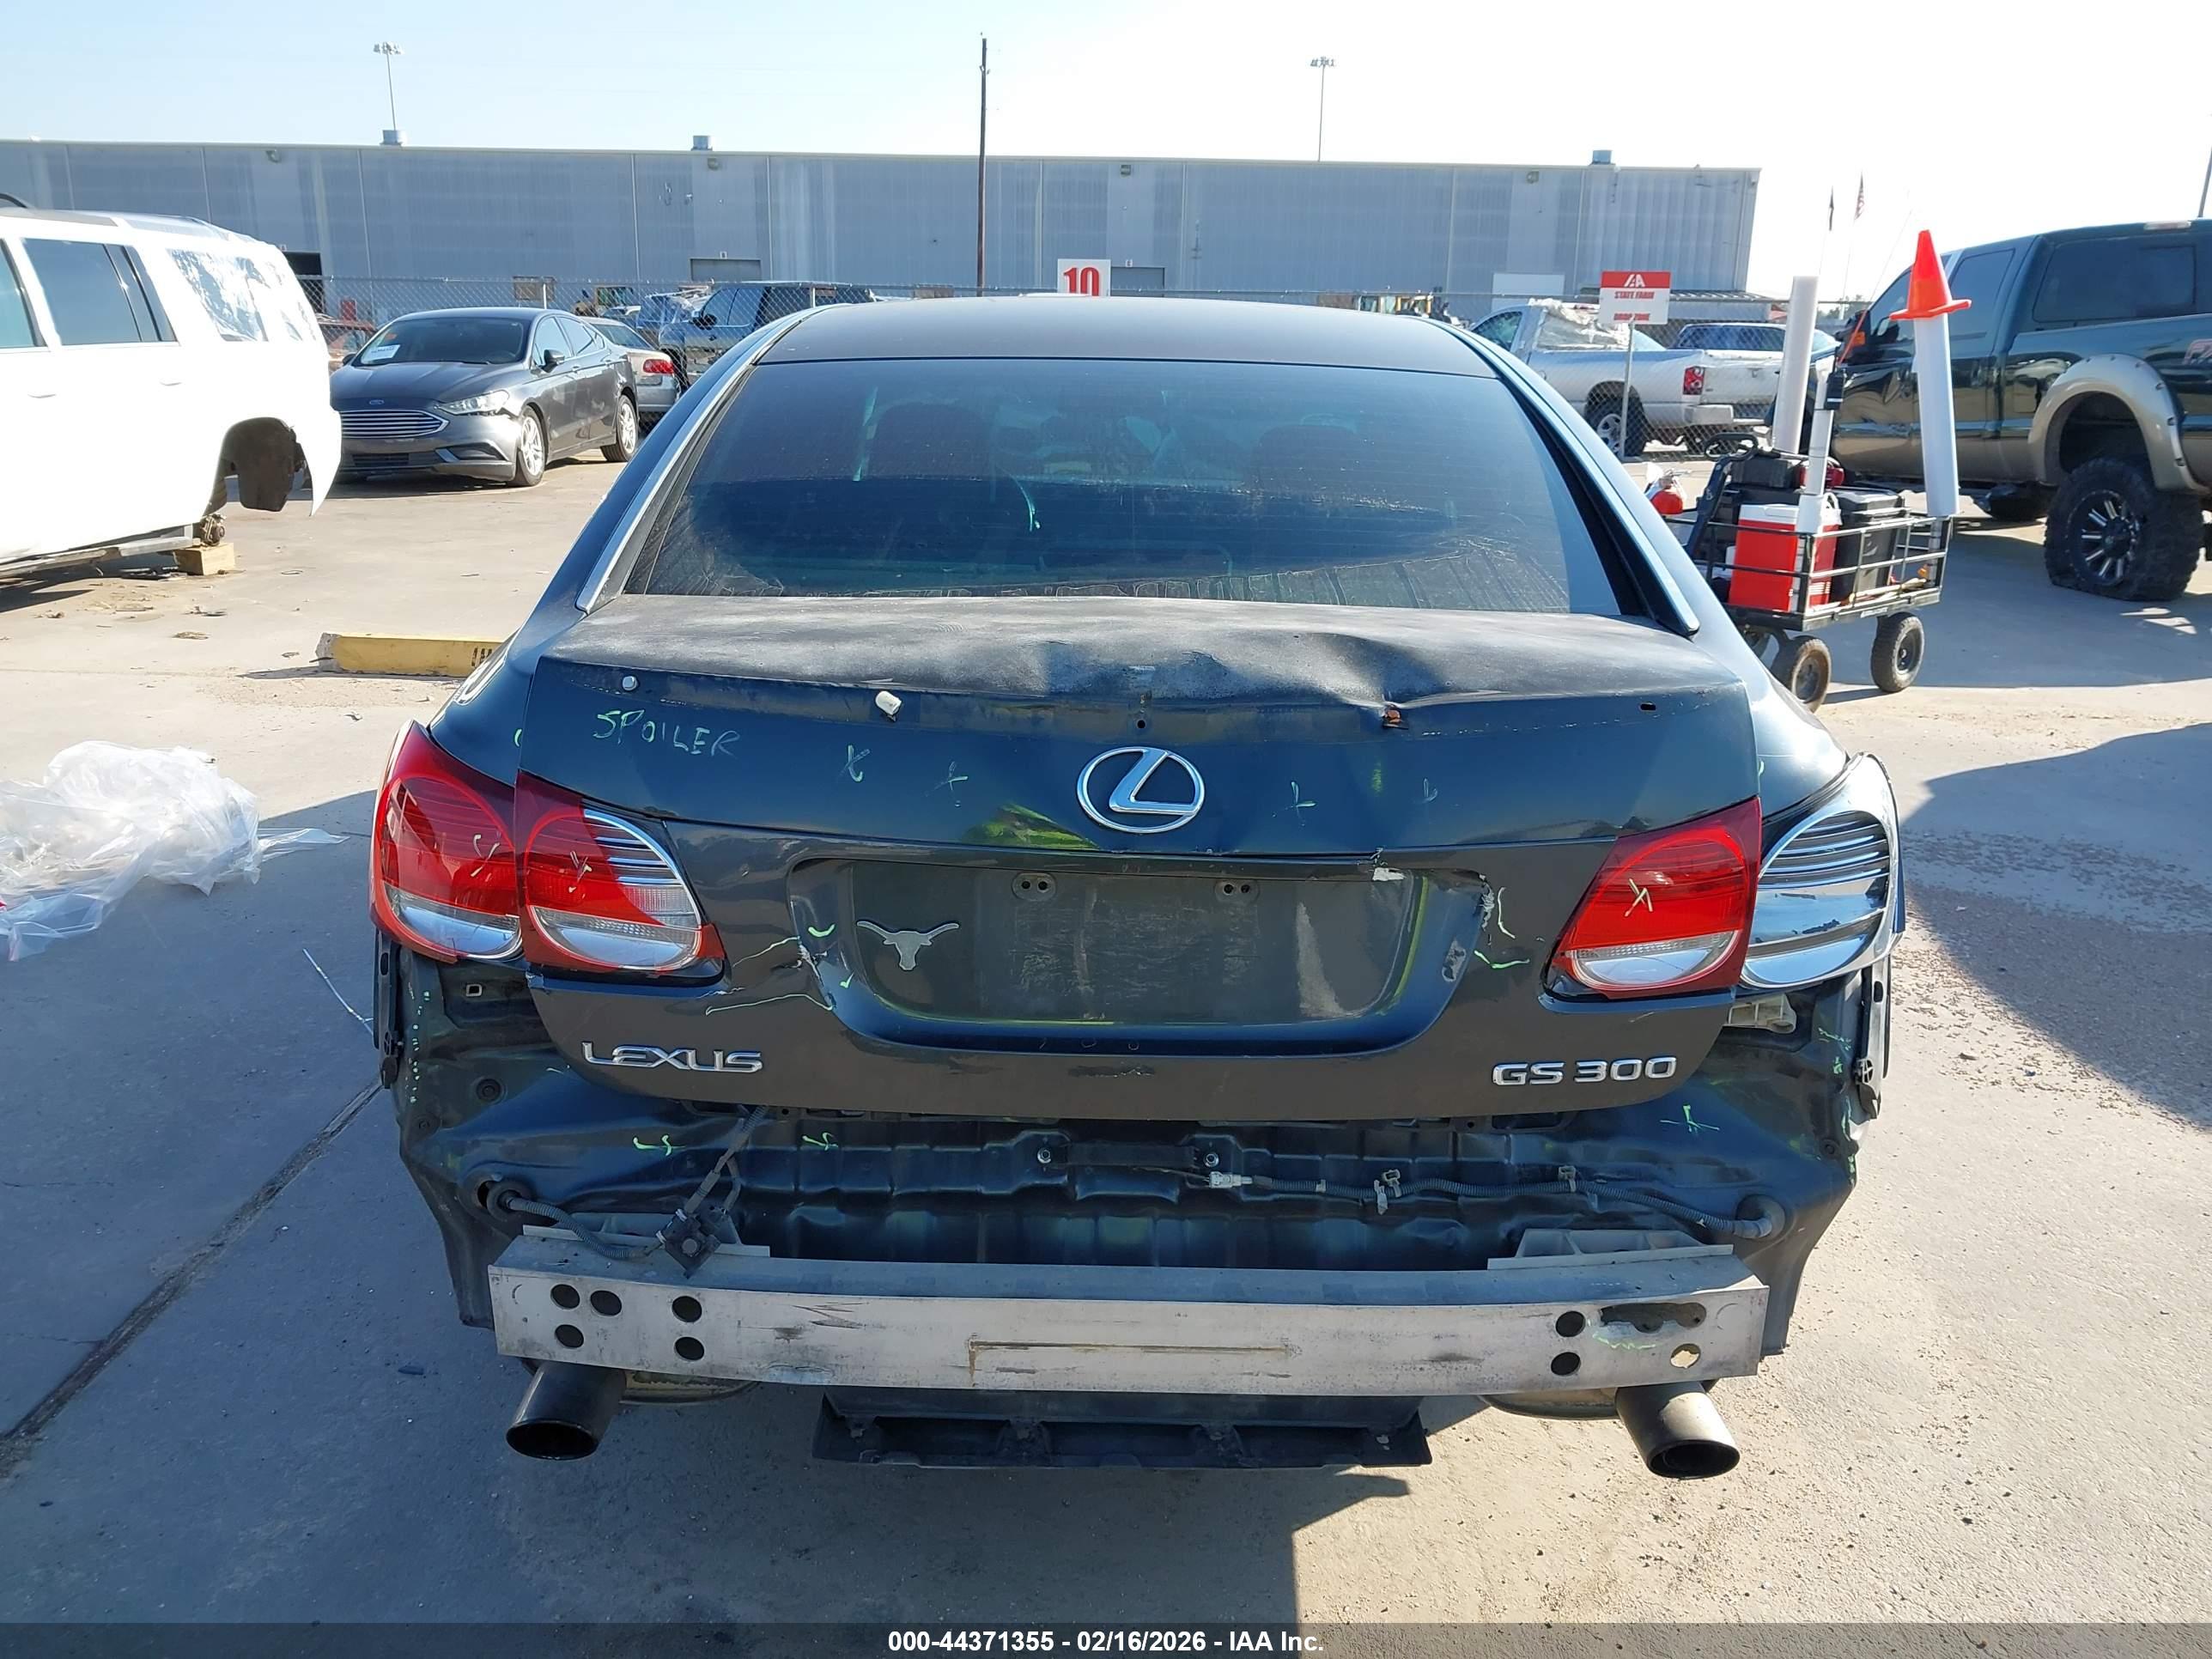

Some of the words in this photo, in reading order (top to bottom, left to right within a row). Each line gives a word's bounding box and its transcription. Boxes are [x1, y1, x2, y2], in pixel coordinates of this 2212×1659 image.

[1063, 267, 1099, 296] 10
[592, 709, 741, 757] SPOILER
[582, 1042, 763, 1073] LEXUS
[1492, 1062, 1565, 1085] GS
[1574, 1056, 1677, 1083] 300
